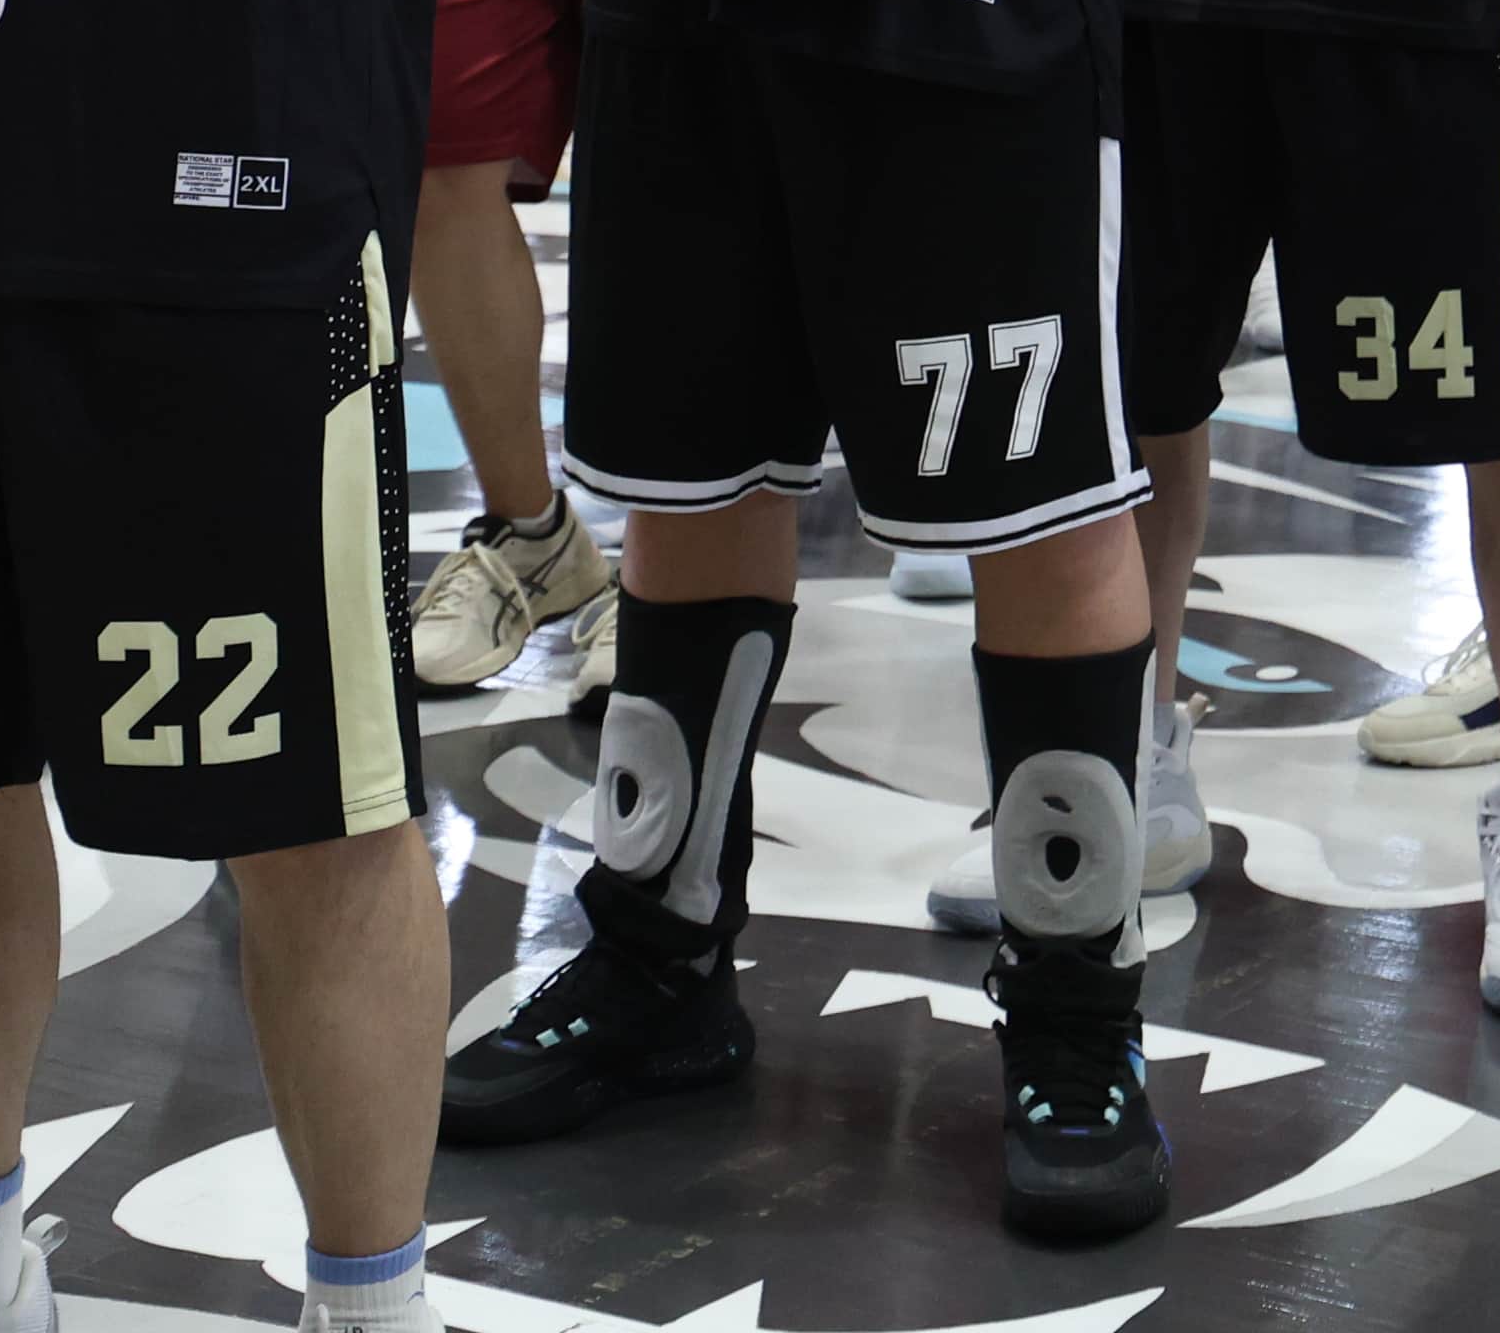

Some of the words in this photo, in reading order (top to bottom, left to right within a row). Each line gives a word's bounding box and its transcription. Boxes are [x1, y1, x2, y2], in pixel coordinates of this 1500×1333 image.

[240, 175, 281, 194] 2XL
[895, 315, 1063, 476] 77
[1335, 289, 1475, 401] 34
[98, 612, 282, 767] 22
